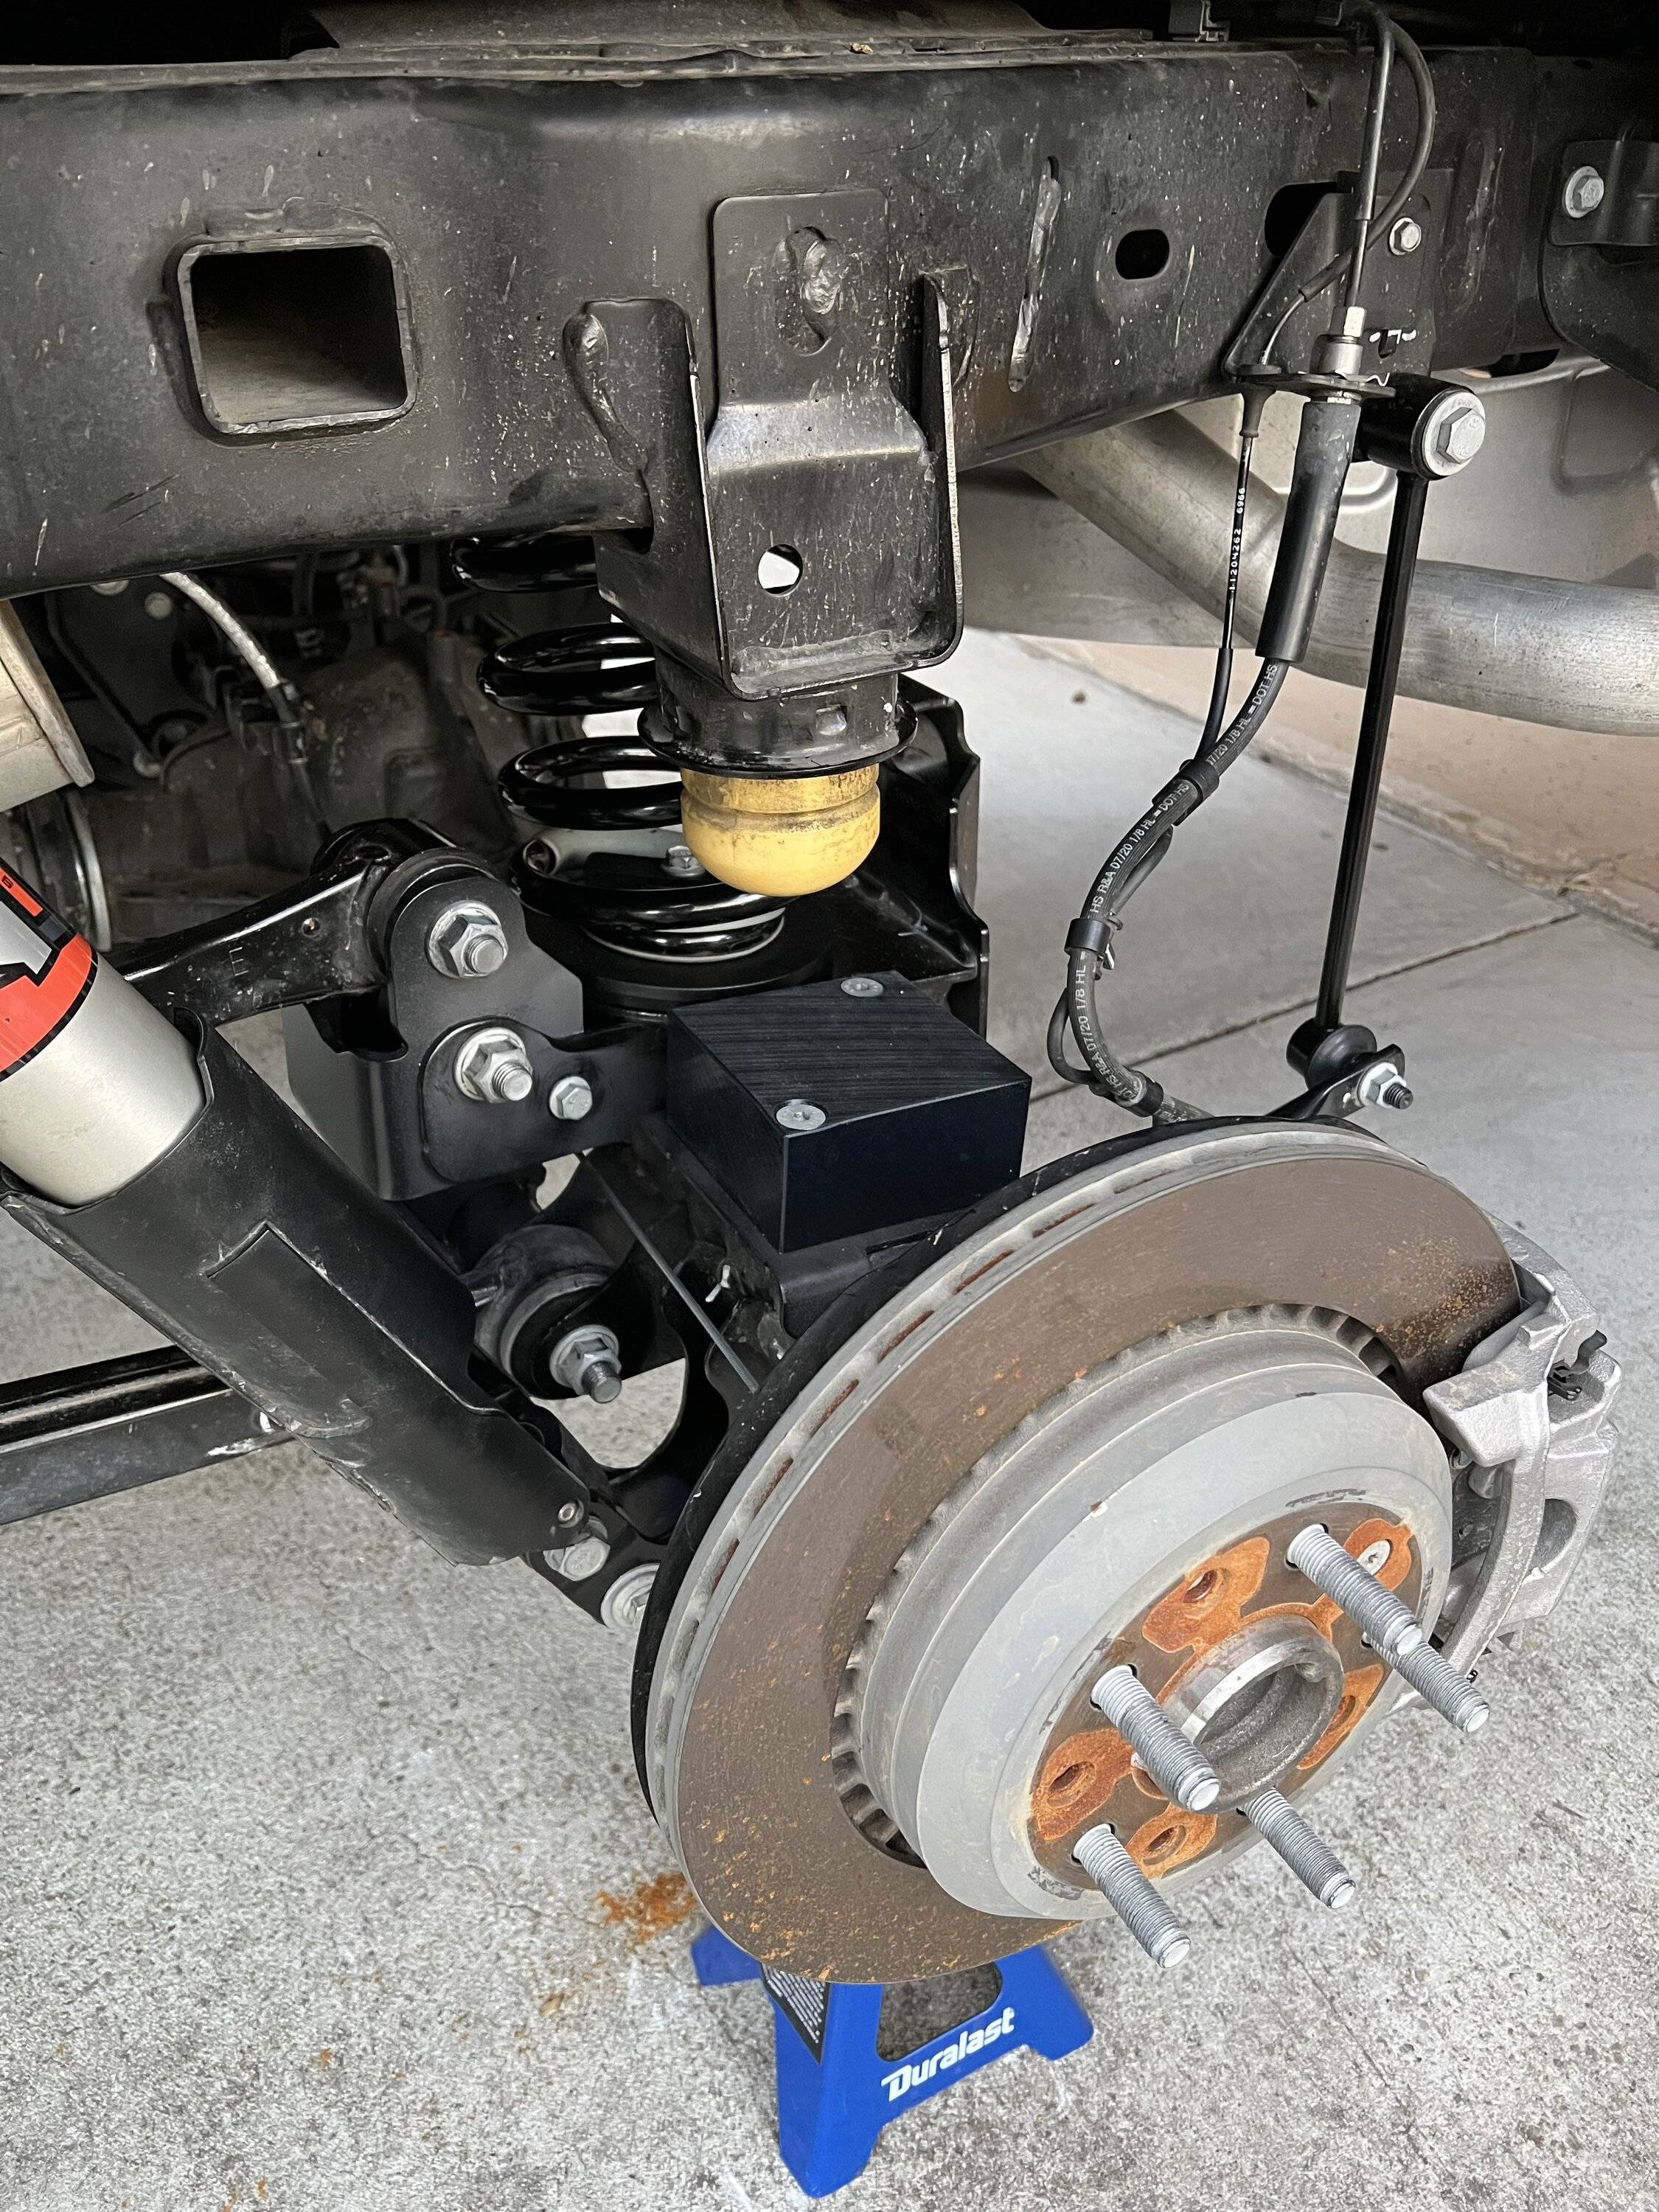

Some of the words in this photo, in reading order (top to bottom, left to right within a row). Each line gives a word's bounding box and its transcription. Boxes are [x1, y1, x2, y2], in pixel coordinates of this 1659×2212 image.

[1090, 895, 1104, 913] HS
[1110, 843, 1133, 869] 07/20
[1130, 828, 1145, 842] 1/8
[1141, 818, 1155, 830] HL
[1075, 965, 1086, 984] HL
[1075, 988, 1086, 1009] 1/8
[1078, 1015, 1097, 1051] 07/20
[881, 2006, 1015, 2101] Duralast
